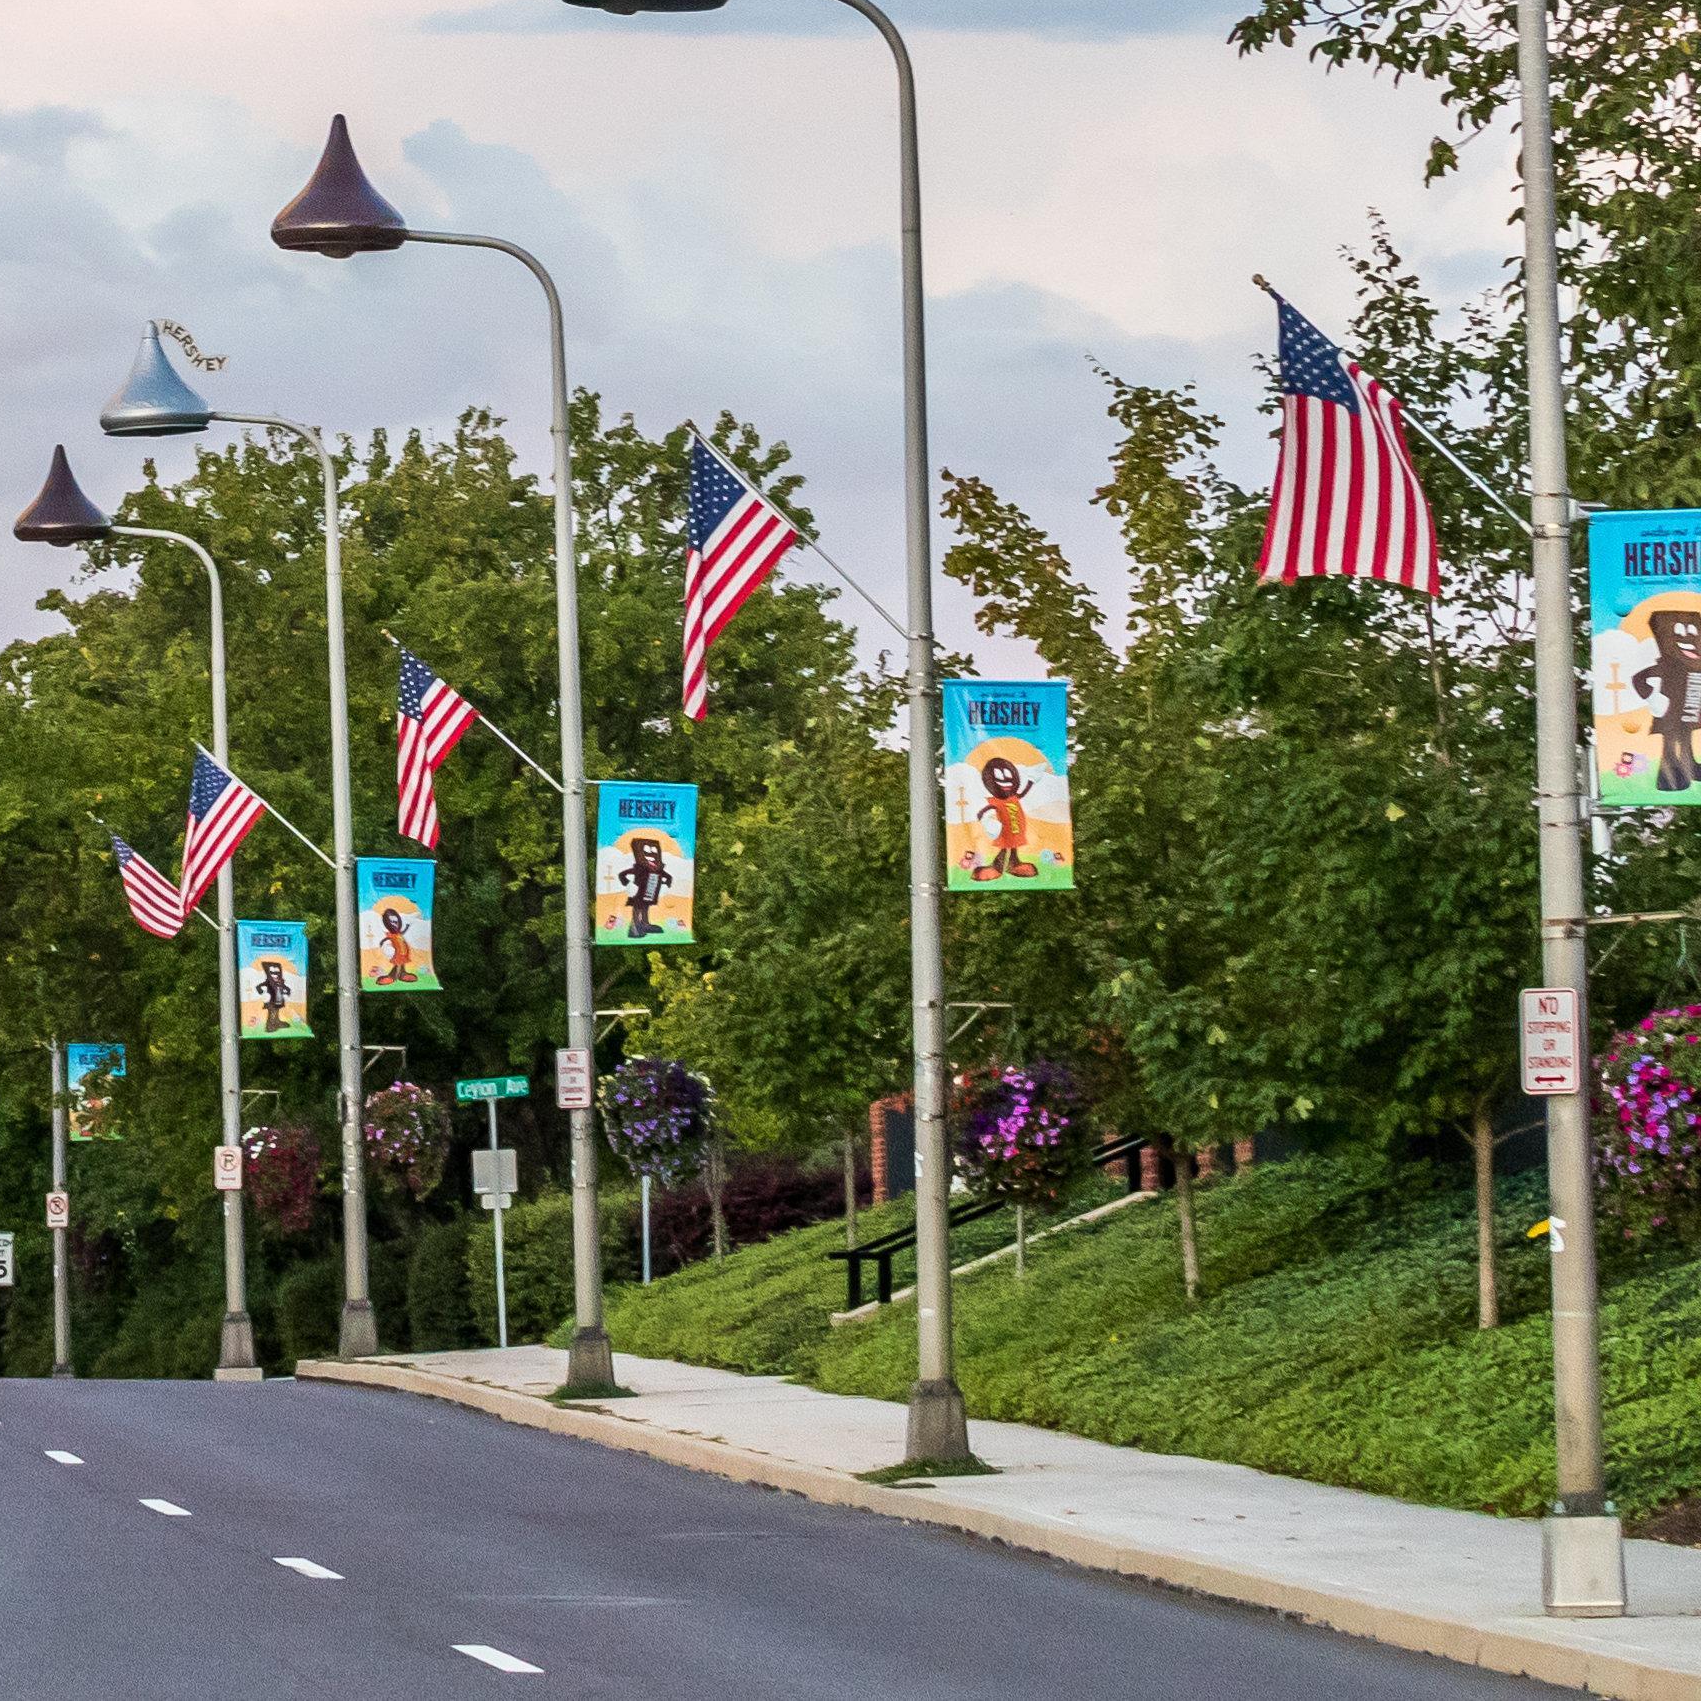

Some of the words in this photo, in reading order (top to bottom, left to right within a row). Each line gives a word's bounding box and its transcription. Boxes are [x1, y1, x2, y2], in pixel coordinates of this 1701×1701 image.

[162, 320, 227, 372] HERSHEY
[1624, 541, 1701, 577] HERSH
[969, 701, 1041, 726] HERSHEY
[619, 799, 676, 819] HERSHEY
[1539, 997, 1558, 1015] NO
[506, 1079, 529, 1095] Ave
